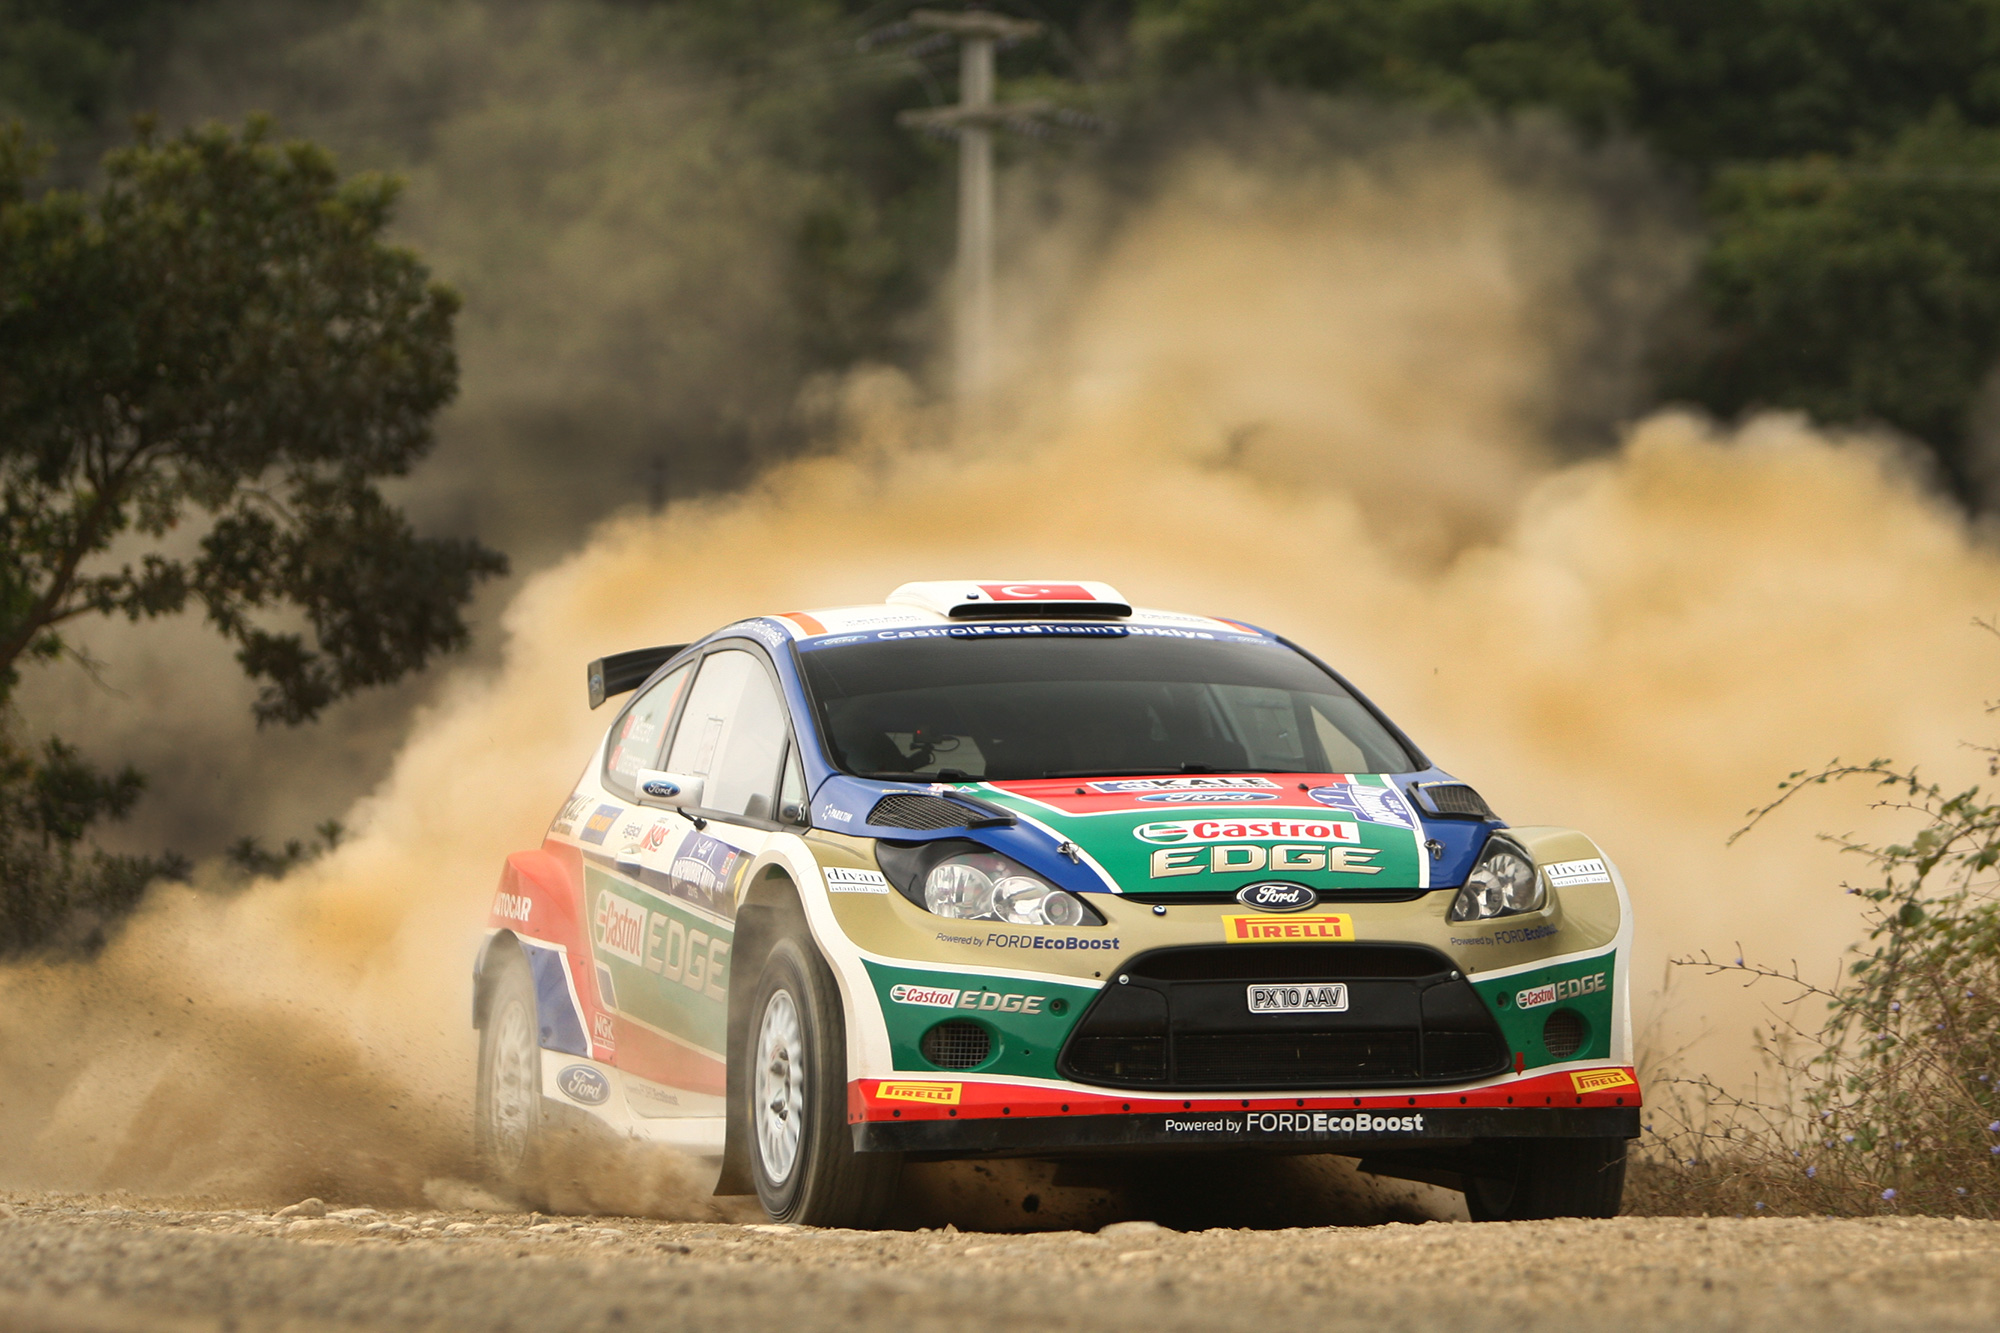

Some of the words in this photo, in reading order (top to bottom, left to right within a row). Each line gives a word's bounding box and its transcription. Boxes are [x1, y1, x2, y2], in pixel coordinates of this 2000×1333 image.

[647, 781, 673, 795] Ford
[1164, 793, 1254, 801] Ford
[1193, 821, 1350, 840] Castrol
[1150, 844, 1386, 879] EDGE
[1548, 863, 1603, 876] divan
[827, 867, 884, 883] divan
[1256, 885, 1300, 903] Ford
[606, 901, 644, 957] Castrol
[1234, 916, 1342, 938] PIRELLI
[936, 932, 974, 945] Powered
[973, 936, 984, 947] by
[986, 933, 1120, 950] FORDEcoBoost
[1450, 936, 1485, 947] Powered
[1485, 936, 1495, 946] by
[646, 911, 731, 1002] EDGE
[1557, 972, 1607, 1000] EDGE
[906, 988, 955, 1005] Castrol
[956, 990, 1046, 1014] EDGE
[1254, 988, 1300, 1008] PX10
[1302, 986, 1342, 1008] AAV
[1528, 987, 1555, 1006] Castrol
[594, 1016, 615, 1040] NGK
[568, 1068, 601, 1097] Ford
[1580, 1072, 1627, 1089] PIRELLI
[885, 1085, 954, 1100] PIRELLI
[1165, 1119, 1223, 1132] Powered
[1226, 1118, 1242, 1134] by
[1246, 1113, 1424, 1132] FORDEcoBoost
